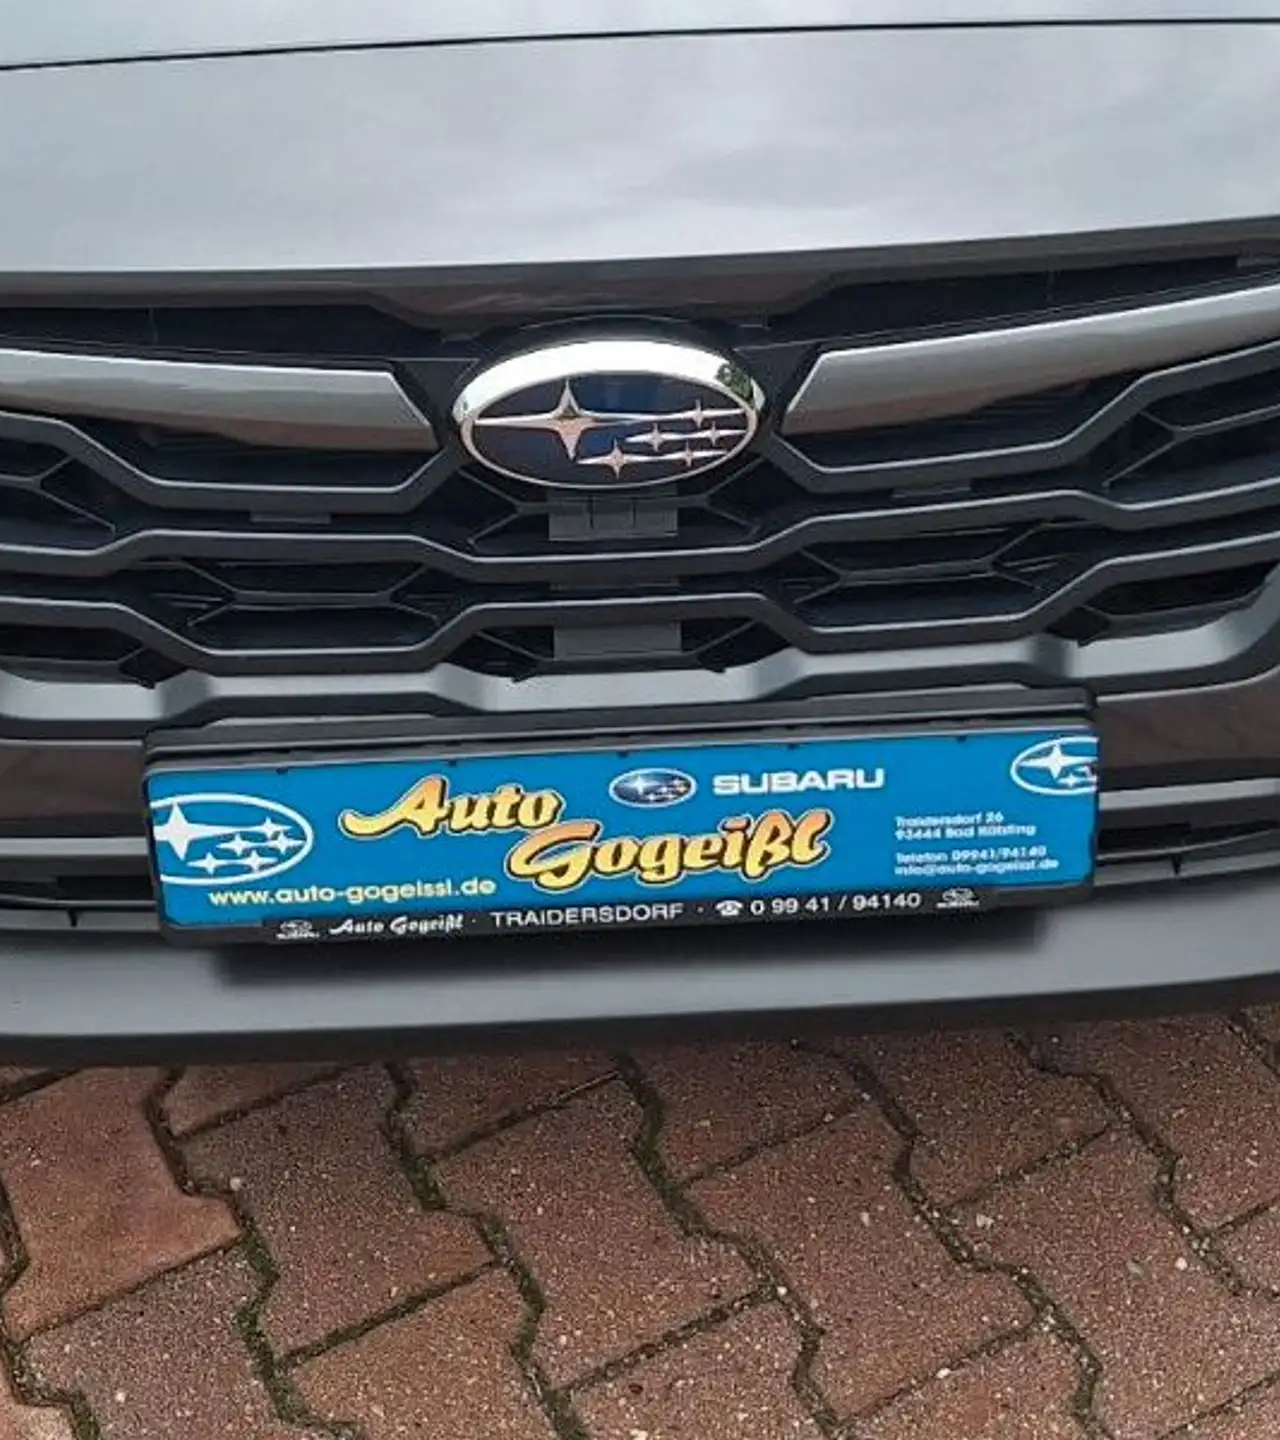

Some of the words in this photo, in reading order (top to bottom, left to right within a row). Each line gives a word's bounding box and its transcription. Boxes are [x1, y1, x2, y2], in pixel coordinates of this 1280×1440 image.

[713, 768, 885, 796] SUBARU
[338, 774, 565, 837] Auto
[504, 808, 836, 893] Gogeißl
[208, 879, 497, 907] www.auto-gogeissl.de
[329, 917, 382, 936] Auto
[490, 902, 684, 928] TRAIDERSDORF
[852, 891, 922, 911] 94140
